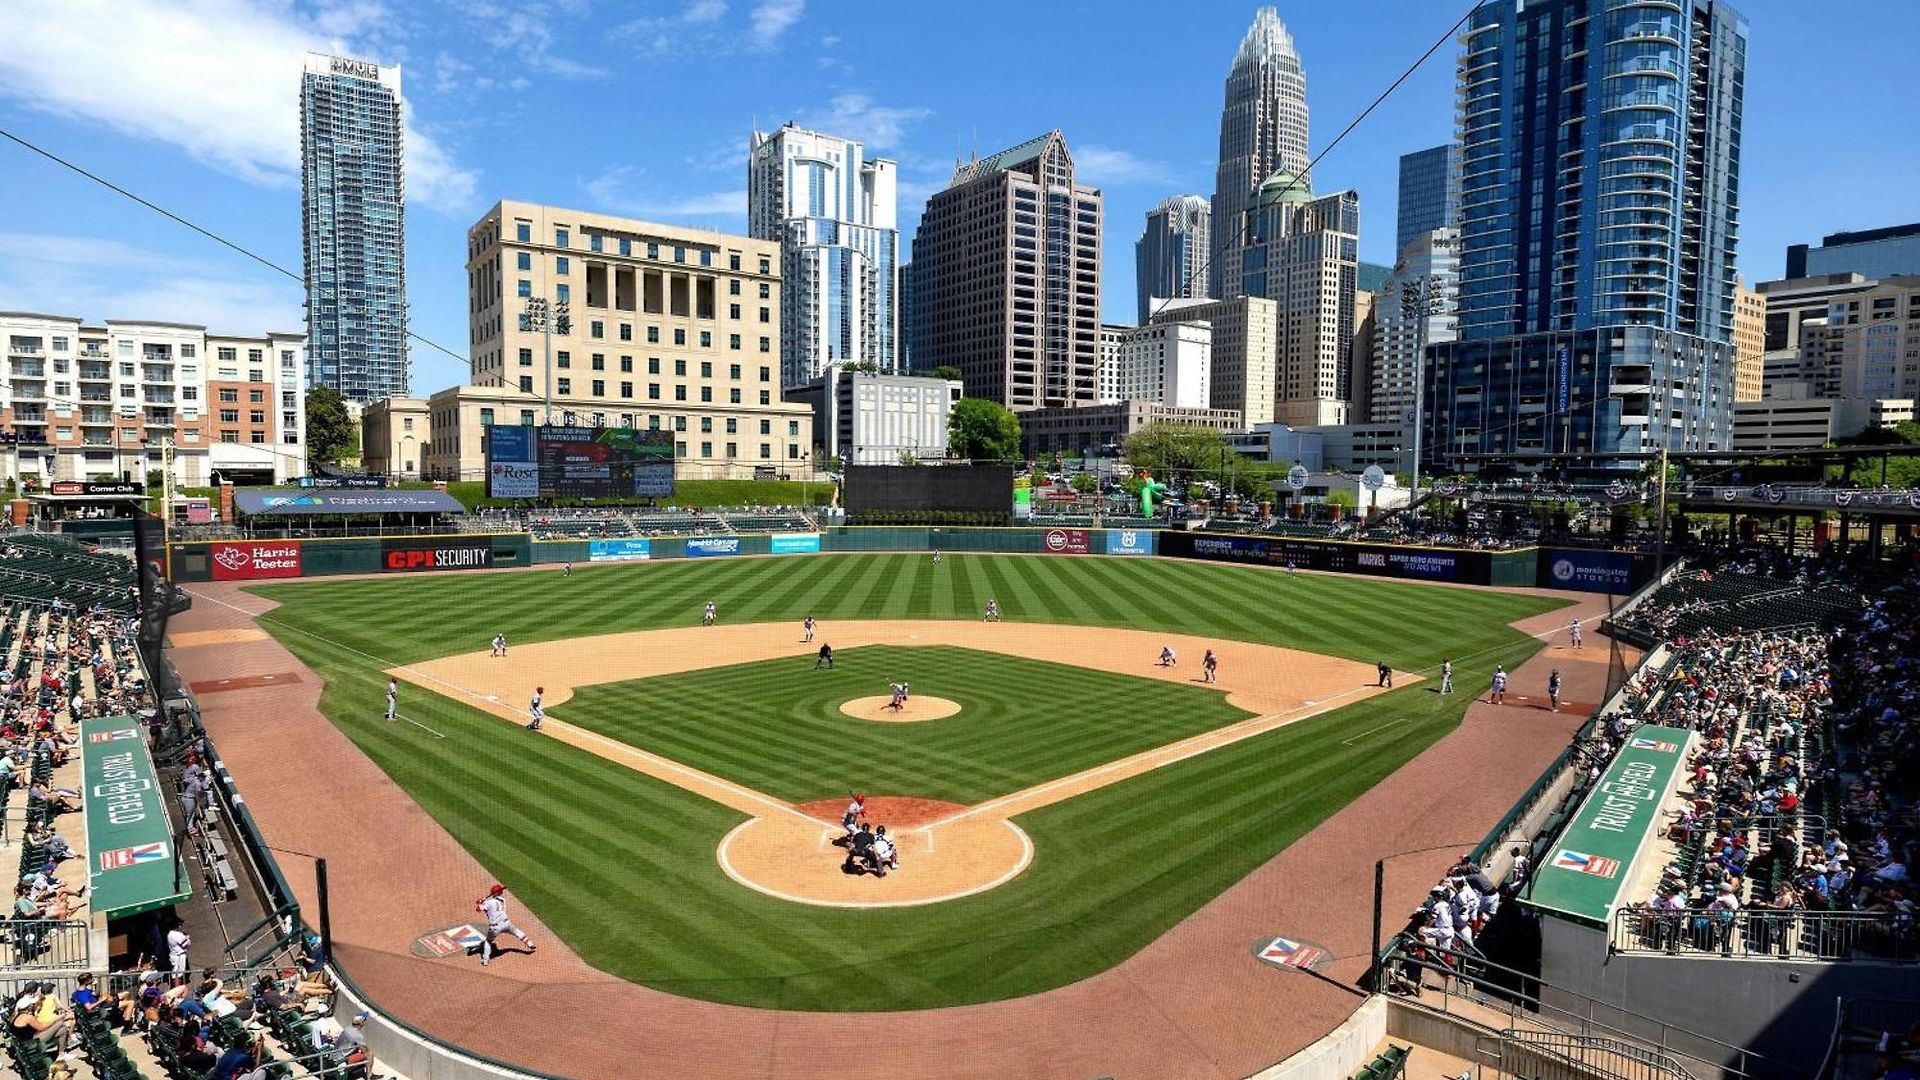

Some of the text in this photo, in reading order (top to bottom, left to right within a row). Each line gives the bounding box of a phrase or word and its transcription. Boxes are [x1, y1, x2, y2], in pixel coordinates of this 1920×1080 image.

[118, 485, 135, 493] Club
[252, 547, 297, 558] Harris
[388, 548, 487, 569] CPI SECURITY
[253, 558, 297, 569] Teeter
[1358, 552, 1386, 566] MARVEL
[1576, 566, 1629, 577] morningstar
[1576, 574, 1628, 584] STORAGE
[102, 751, 137, 782] TRUIST
[1589, 794, 1640, 833] TRUIST
[1619, 761, 1657, 792] FIELD
[107, 793, 147, 825] FIELD
